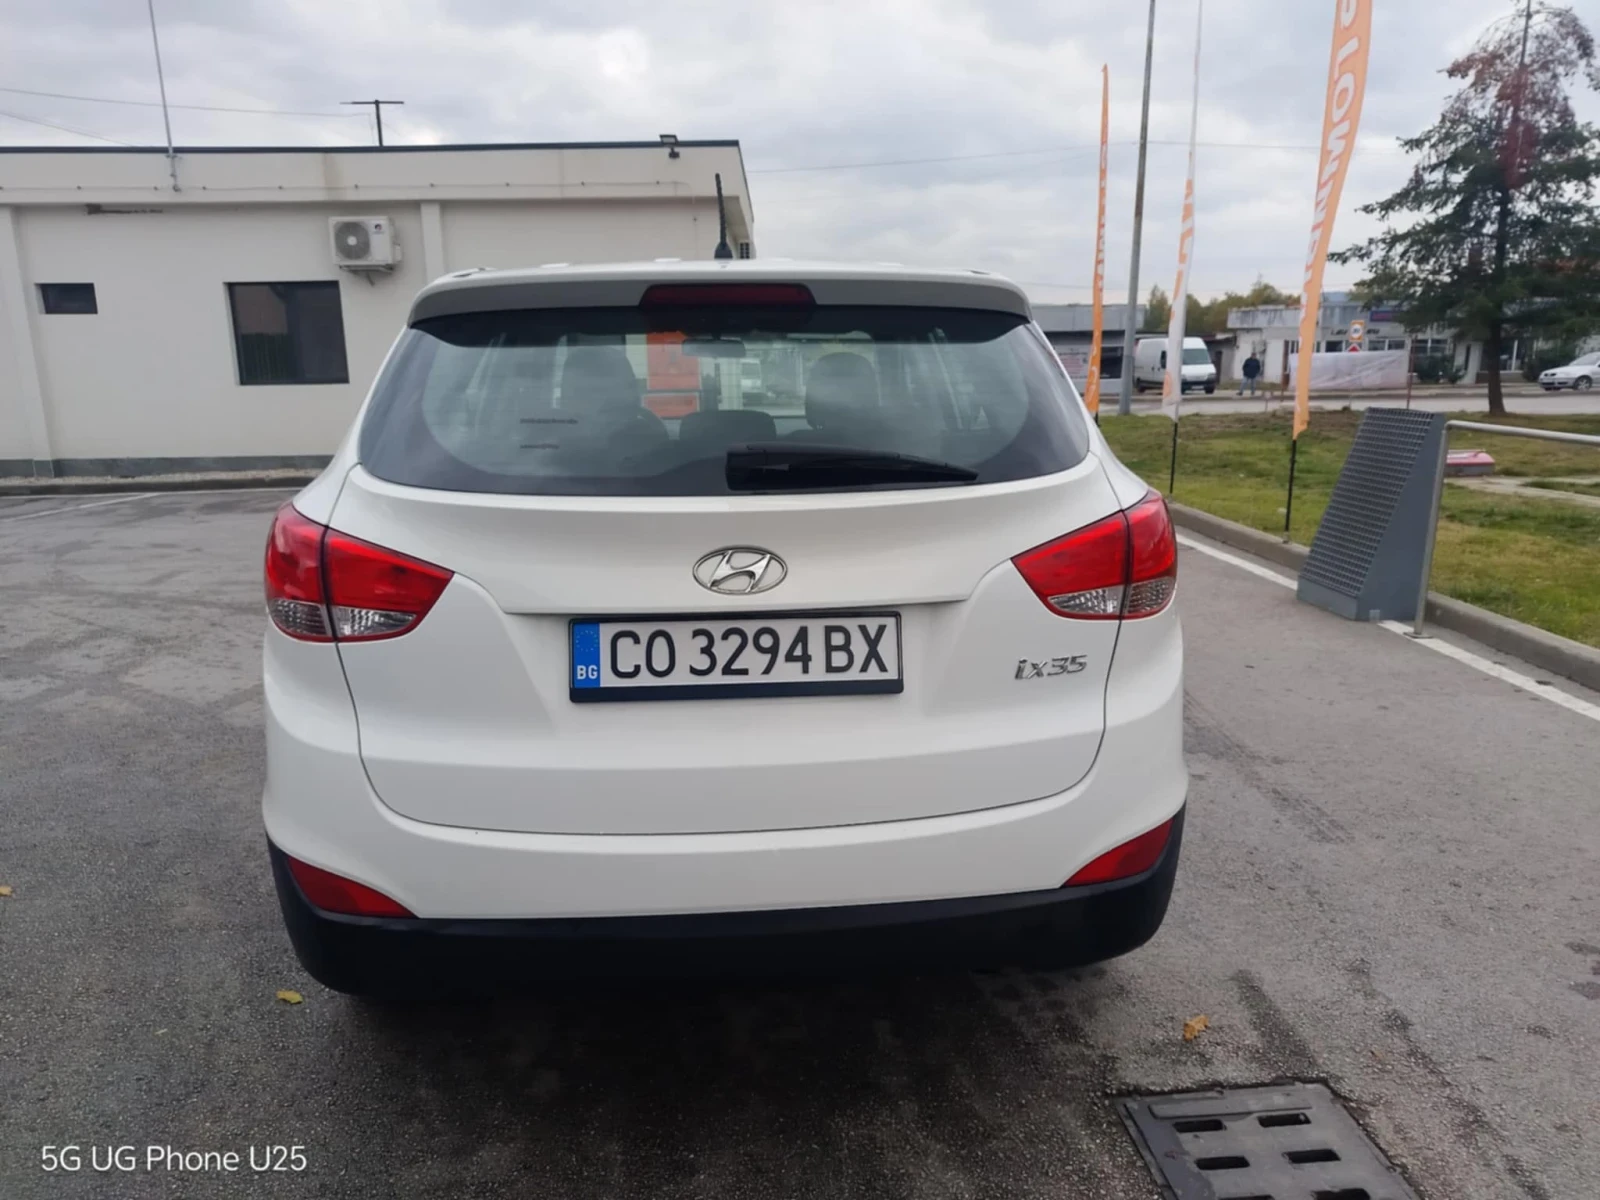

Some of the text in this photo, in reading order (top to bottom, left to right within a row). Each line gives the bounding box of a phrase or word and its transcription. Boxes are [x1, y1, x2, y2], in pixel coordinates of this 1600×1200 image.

[689, 625, 812, 677] 3294
[823, 624, 889, 675] BX
[576, 665, 598, 680] BG
[1014, 654, 1088, 680] ix35
